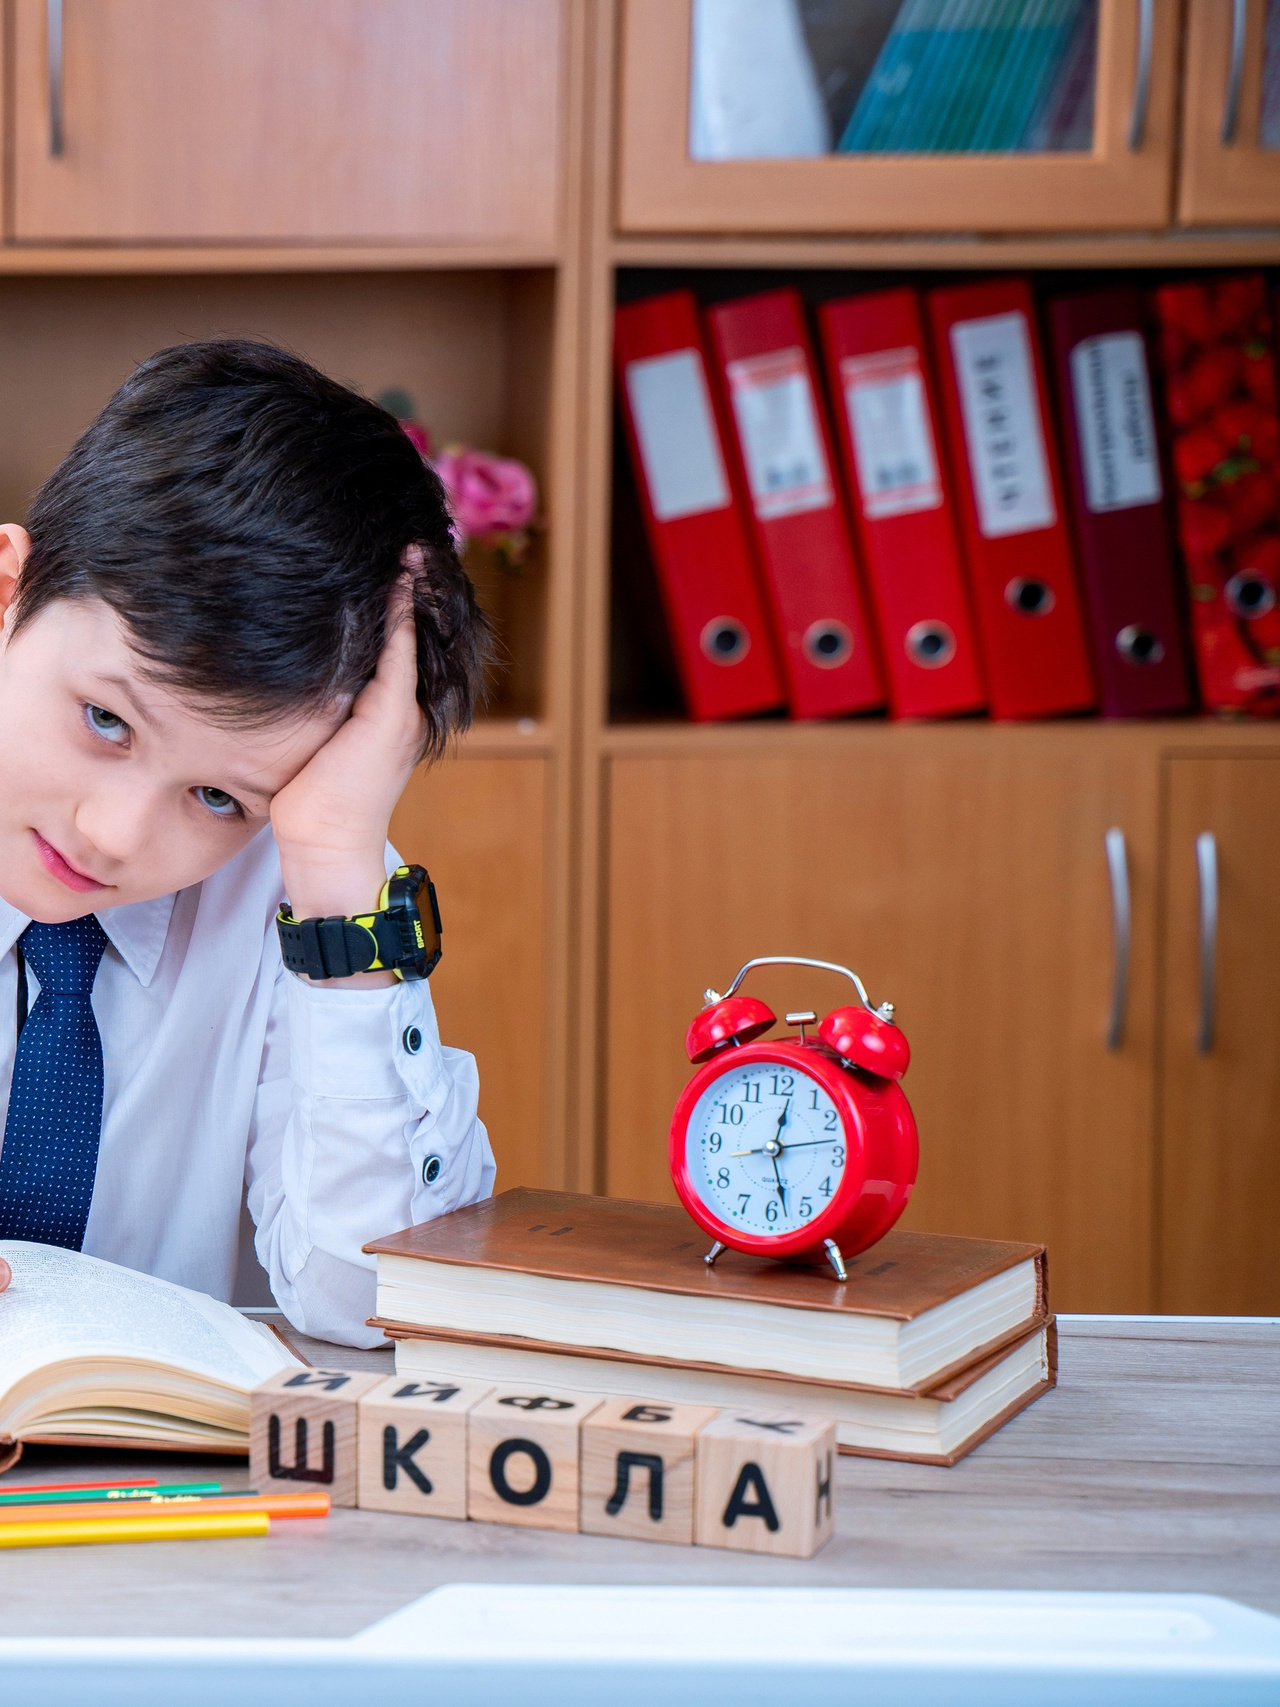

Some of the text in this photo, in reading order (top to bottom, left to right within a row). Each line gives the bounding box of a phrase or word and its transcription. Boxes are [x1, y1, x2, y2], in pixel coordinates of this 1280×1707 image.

[413, 919, 424, 949] SPORT
[741, 1082, 763, 1104] 11
[769, 1074, 795, 1097] 12
[809, 1089, 821, 1110] 1
[718, 1103, 744, 1126] 10
[824, 1110, 837, 1131] 2
[709, 1132, 722, 1154] 9
[831, 1146, 844, 1167] 3
[716, 1167, 730, 1188] 8
[761, 1176, 788, 1185] QUATZ
[819, 1176, 833, 1197] 4
[737, 1193, 751, 1215] 7
[765, 1200, 778, 1222] 6
[799, 1196, 812, 1217] 5
[497, 1395, 575, 1411] Ф
[621, 1403, 673, 1422] Б
[268, 1414, 780, 1532] ШКОЛА
